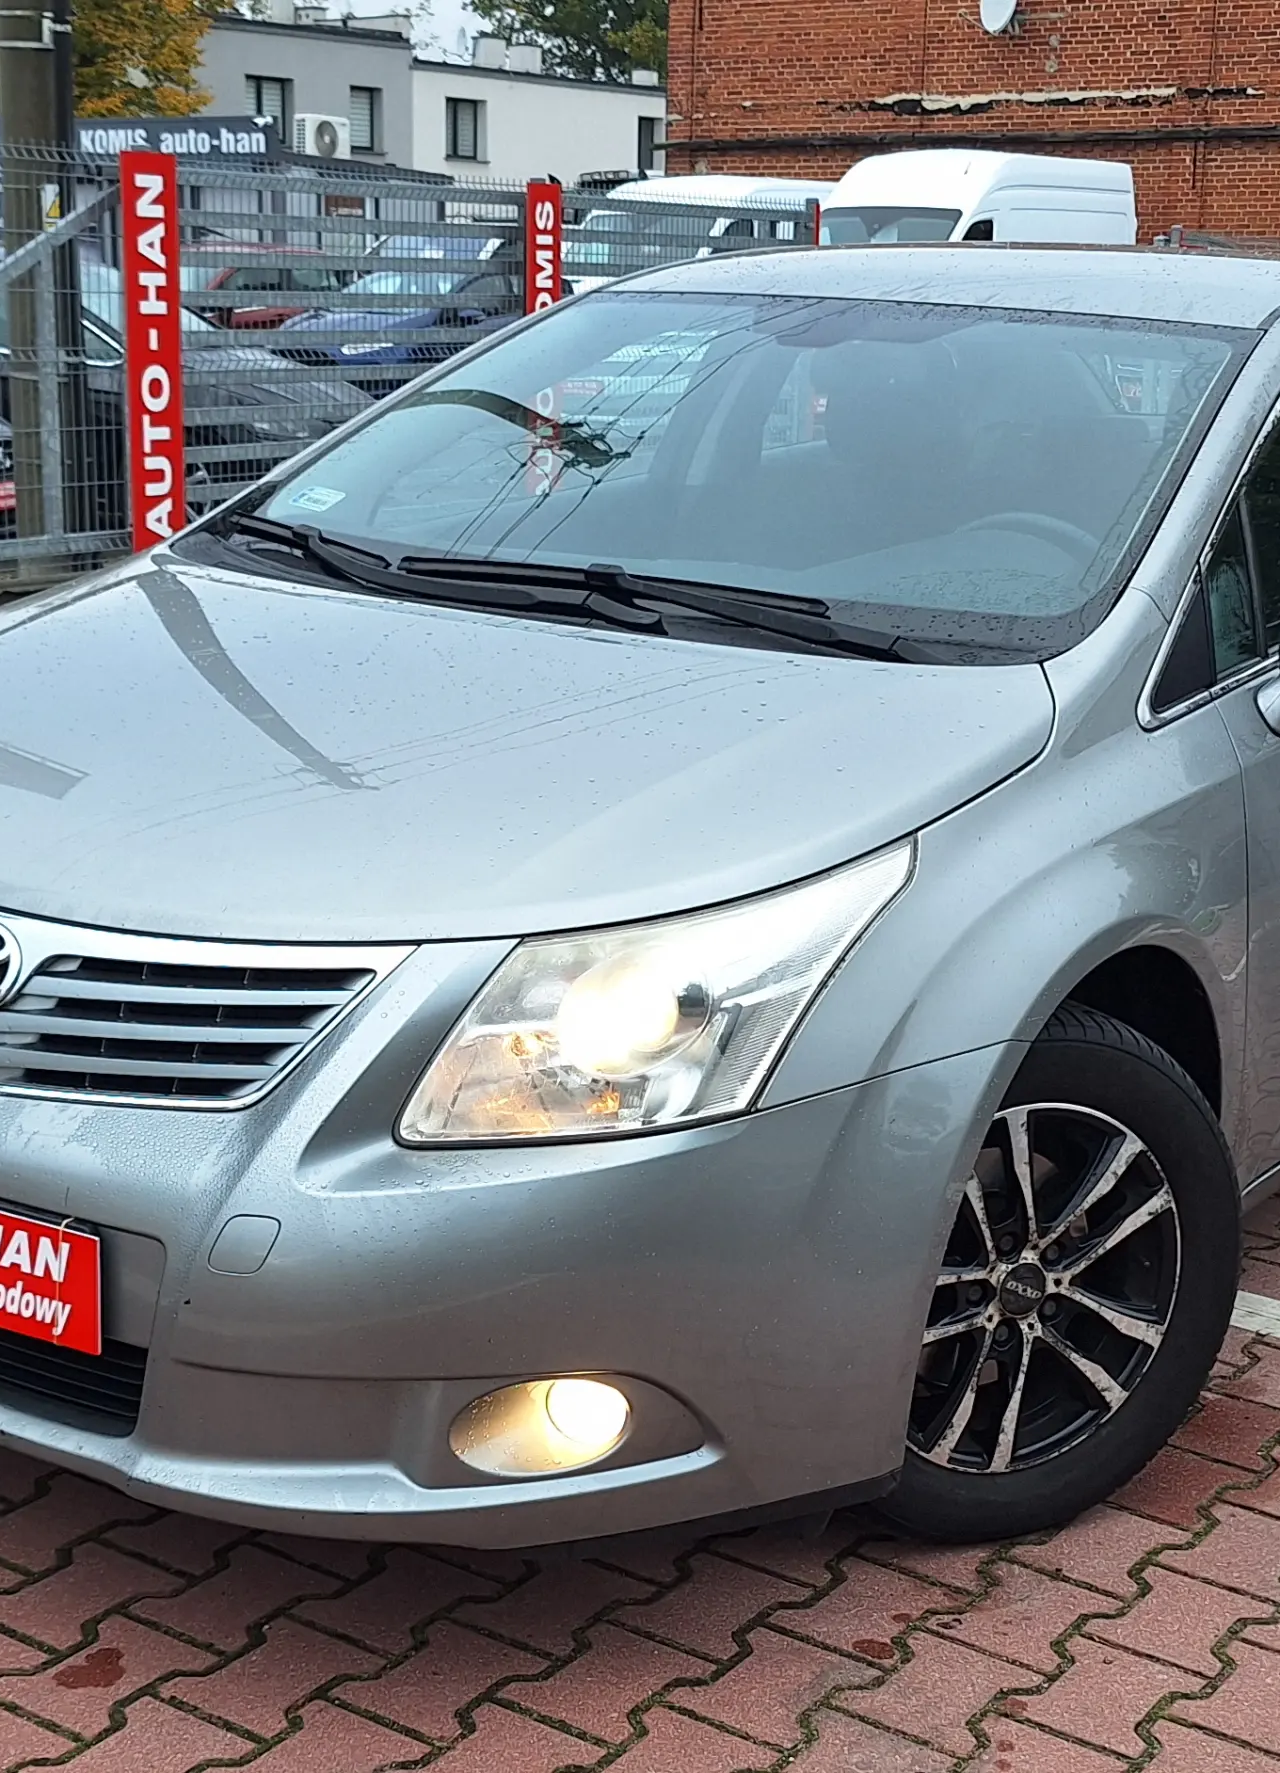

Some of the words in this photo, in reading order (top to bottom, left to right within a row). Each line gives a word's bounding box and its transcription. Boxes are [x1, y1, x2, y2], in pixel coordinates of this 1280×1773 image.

[159, 127, 267, 154] auto-han
[133, 173, 169, 316] HAN
[534, 200, 555, 314] OMIS
[140, 364, 174, 539] AUTO
